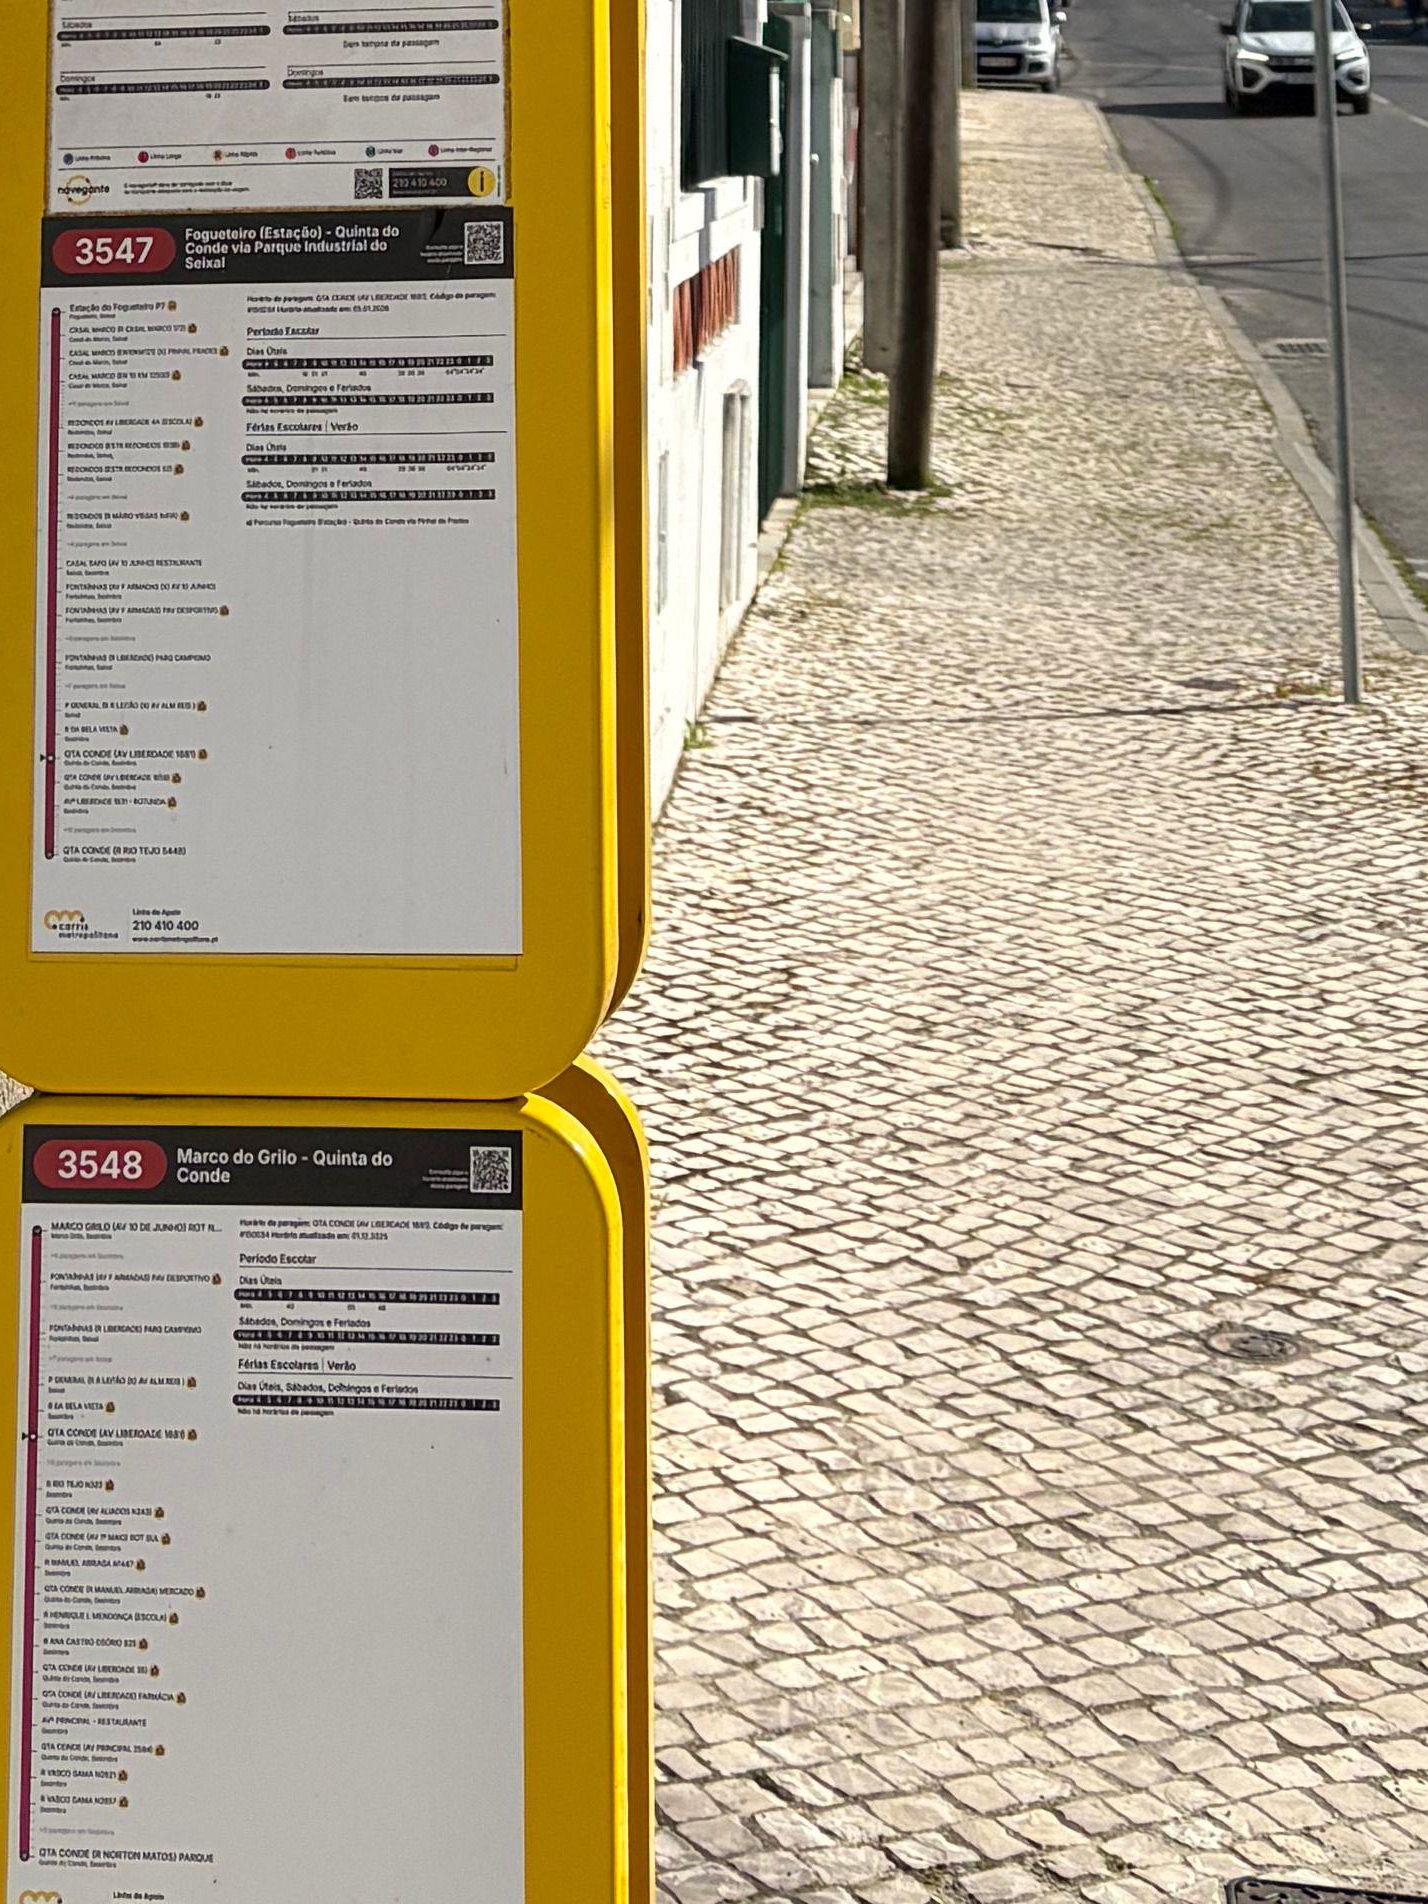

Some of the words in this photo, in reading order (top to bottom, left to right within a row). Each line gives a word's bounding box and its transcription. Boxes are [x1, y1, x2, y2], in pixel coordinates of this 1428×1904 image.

[185, 228, 256, 243] Fogueteiro
[260, 226, 321, 242] (Estação)
[335, 225, 380, 238] Quinta
[383, 225, 400, 237] do
[76, 236, 154, 266] 3547
[185, 242, 228, 254] Conde
[230, 242, 251, 254] via
[254, 240, 301, 256] Parque
[305, 239, 368, 252] Industrial
[371, 240, 387, 252] do
[185, 257, 225, 270] Seixal
[70, 304, 99, 313] Estação
[101, 304, 111, 312] do
[247, 347, 265, 356] Dias
[267, 346, 287, 356] Úteis
[246, 421, 275, 432] Férias
[277, 422, 322, 432] Escolares
[331, 421, 358, 432] Verão
[246, 443, 264, 452] Dias
[267, 442, 286, 452] Úteis
[82, 846, 111, 856] CONDE
[123, 846, 137, 855] RIO
[139, 846, 160, 855] TEJO
[133, 921, 151, 931] 210
[155, 921, 174, 931] 410
[177, 920, 199, 931] 400
[177, 1148, 229, 1165] Marco
[233, 1148, 254, 1165] do
[258, 1149, 297, 1166] Grilo
[313, 1149, 368, 1167] Quinta
[371, 1151, 393, 1167] do
[58, 1149, 142, 1180] 3548
[177, 1167, 231, 1183] Conde
[240, 1253, 277, 1265] Período
[280, 1254, 316, 1265] Escolar
[239, 1275, 258, 1286] Dias
[260, 1275, 282, 1286] Úteis
[281, 1317, 324, 1329] Domingos
[334, 1318, 371, 1328] Feriados
[238, 1358, 268, 1370] Férias
[271, 1359, 319, 1371] Escolares
[327, 1360, 357, 1371] Verão
[237, 1381, 257, 1391] Dias
[381, 1384, 418, 1394] Feriados
[59, 1848, 90, 1859] CONDE
[179, 1852, 214, 1863] PARQUE
